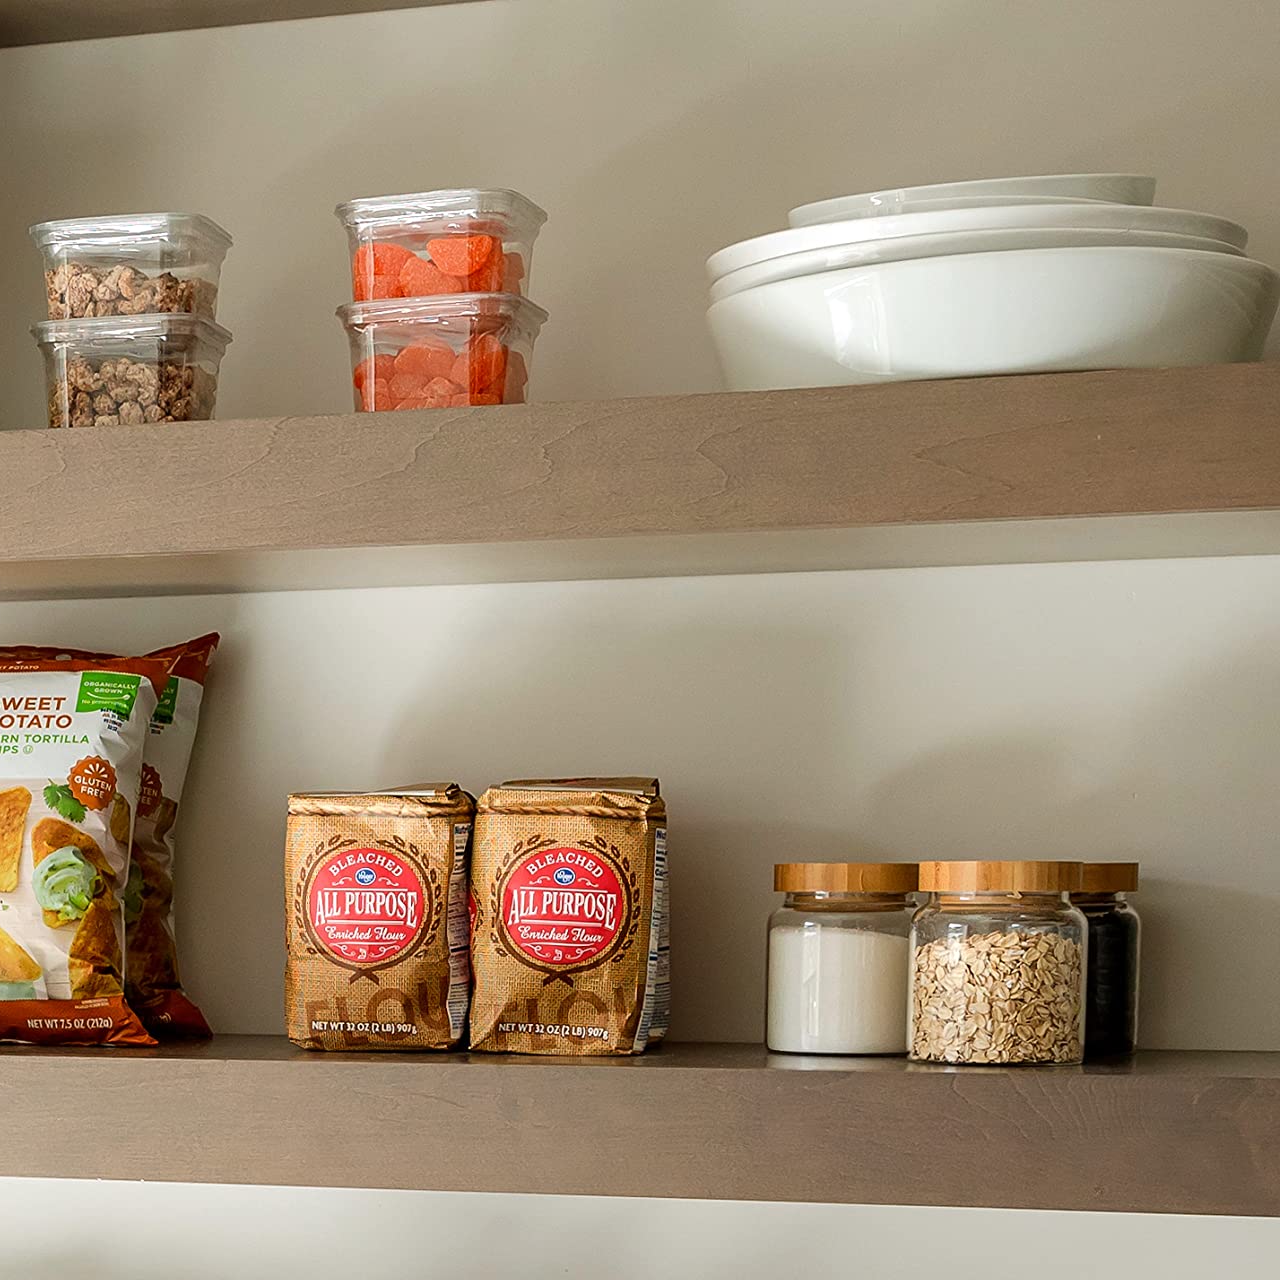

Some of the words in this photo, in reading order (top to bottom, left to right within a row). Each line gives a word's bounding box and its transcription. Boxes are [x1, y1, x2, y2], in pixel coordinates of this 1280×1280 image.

[83, 681, 137, 690] ORGANICALLY
[24, 734, 90, 744] TORTILLA
[74, 775, 112, 791] GLUTEN
[80, 785, 105, 799] FREE
[141, 786, 158, 796] TEN
[141, 797, 152, 805] EE
[328, 852, 403, 877] BLEACHED
[526, 852, 604, 878] BLEACHED
[315, 890, 341, 927] ALL
[344, 891, 418, 928] PURPOSE
[507, 889, 538, 926] ALL
[541, 891, 617, 931] PURPOSE
[324, 926, 373, 940] Enriched
[373, 926, 406, 940] Flour
[517, 925, 570, 941] Enriched
[571, 927, 604, 942] Flour
[27, 1019, 43, 1029] NET
[44, 1018, 58, 1029] WT
[59, 1018, 72, 1028] 7.5
[74, 1018, 85, 1028] OZ
[311, 1021, 327, 1031] NET
[329, 1021, 345, 1031] WT
[346, 1022, 355, 1032] 32
[357, 1022, 370, 1032] OZ
[371, 1022, 380, 1034] (2
[381, 1023, 396, 1034] LB)
[498, 1023, 516, 1032] NET
[517, 1023, 533, 1033] WT
[535, 1023, 544, 1033] 32
[546, 1025, 560, 1035] OZ
[561, 1025, 570, 1037] (2
[571, 1026, 586, 1038] LB)
[587, 1027, 609, 1040] 907g
